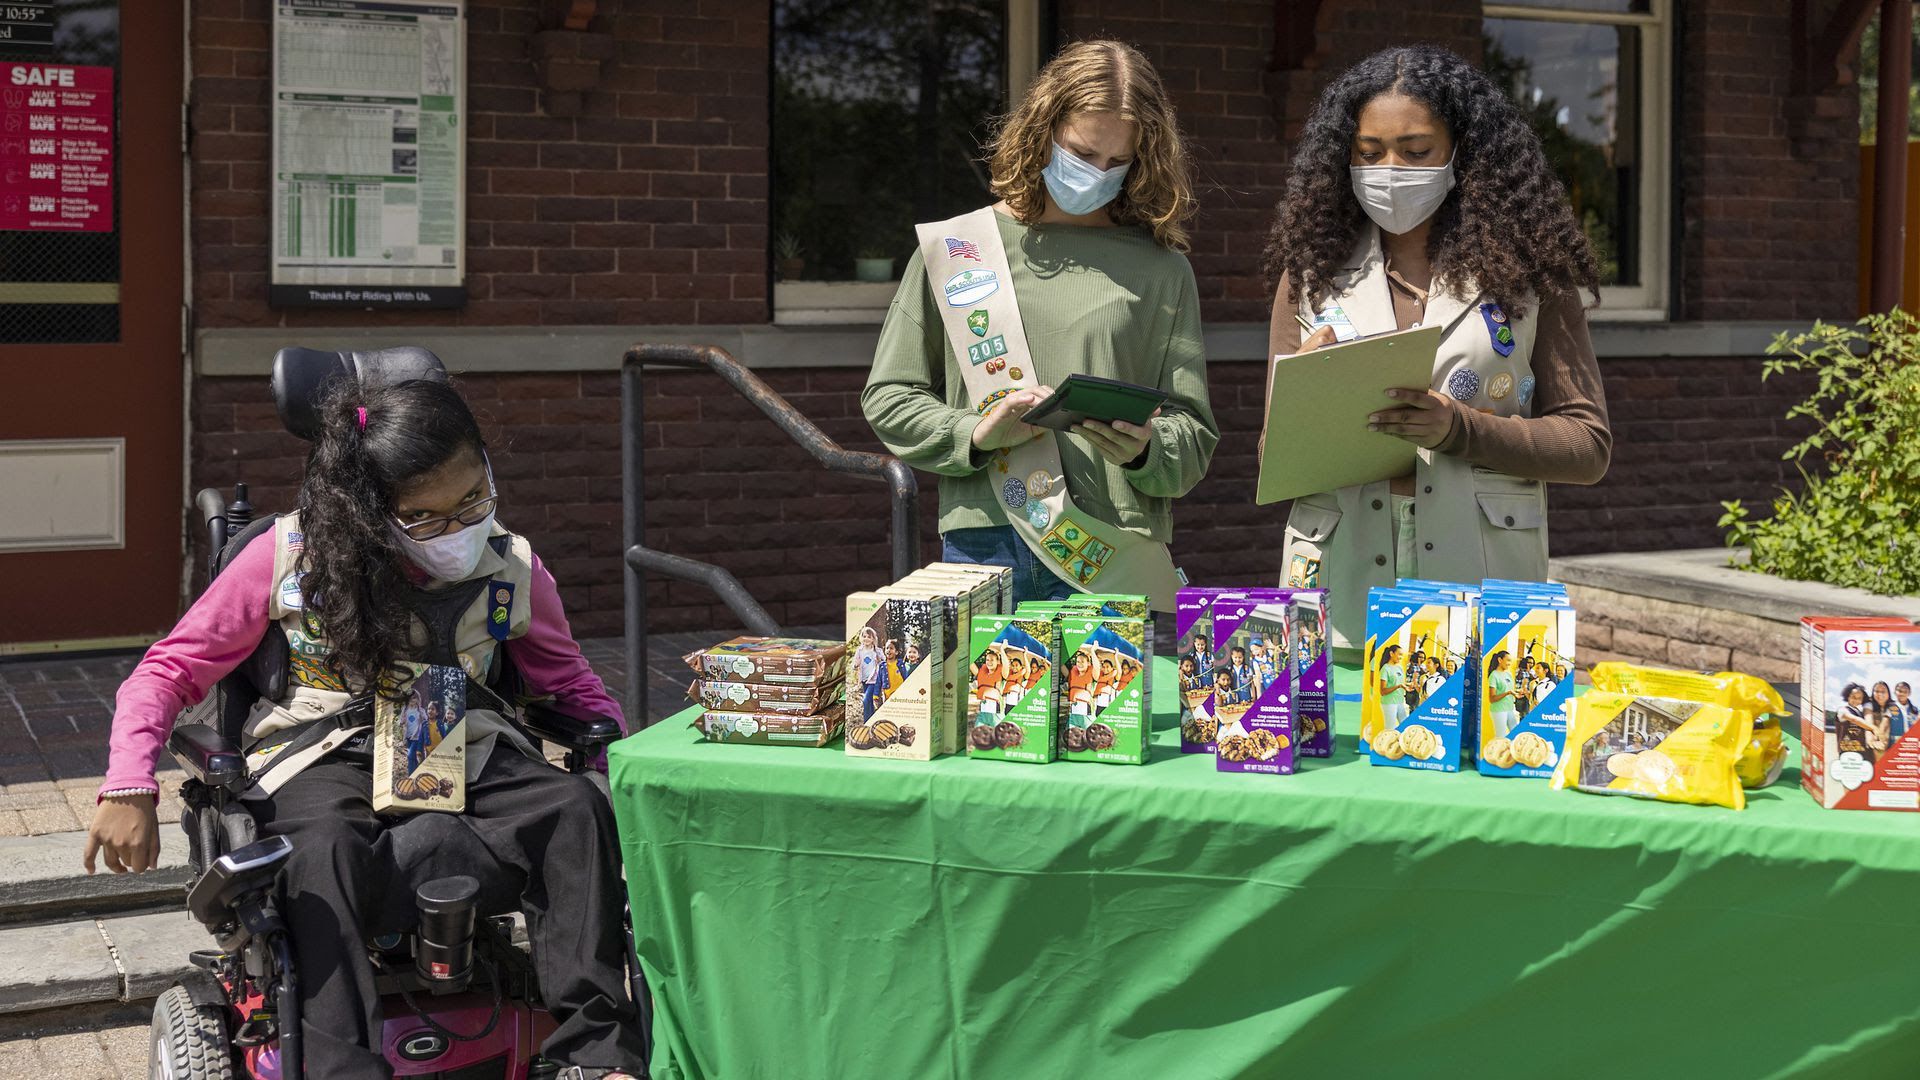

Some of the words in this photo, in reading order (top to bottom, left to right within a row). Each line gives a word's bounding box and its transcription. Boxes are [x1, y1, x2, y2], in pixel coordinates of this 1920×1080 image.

[11, 66, 75, 87] SAFE
[32, 90, 56, 99] WAIT
[28, 98, 56, 107] SAFE
[30, 122, 56, 130] SAFE
[30, 146, 56, 155] SAFE
[30, 204, 56, 212] SAFE
[309, 290, 343, 301] Thanks
[345, 291, 362, 301] For
[363, 291, 392, 302] Riding
[393, 292, 415, 301] With
[1431, 707, 1458, 716] trefoils
